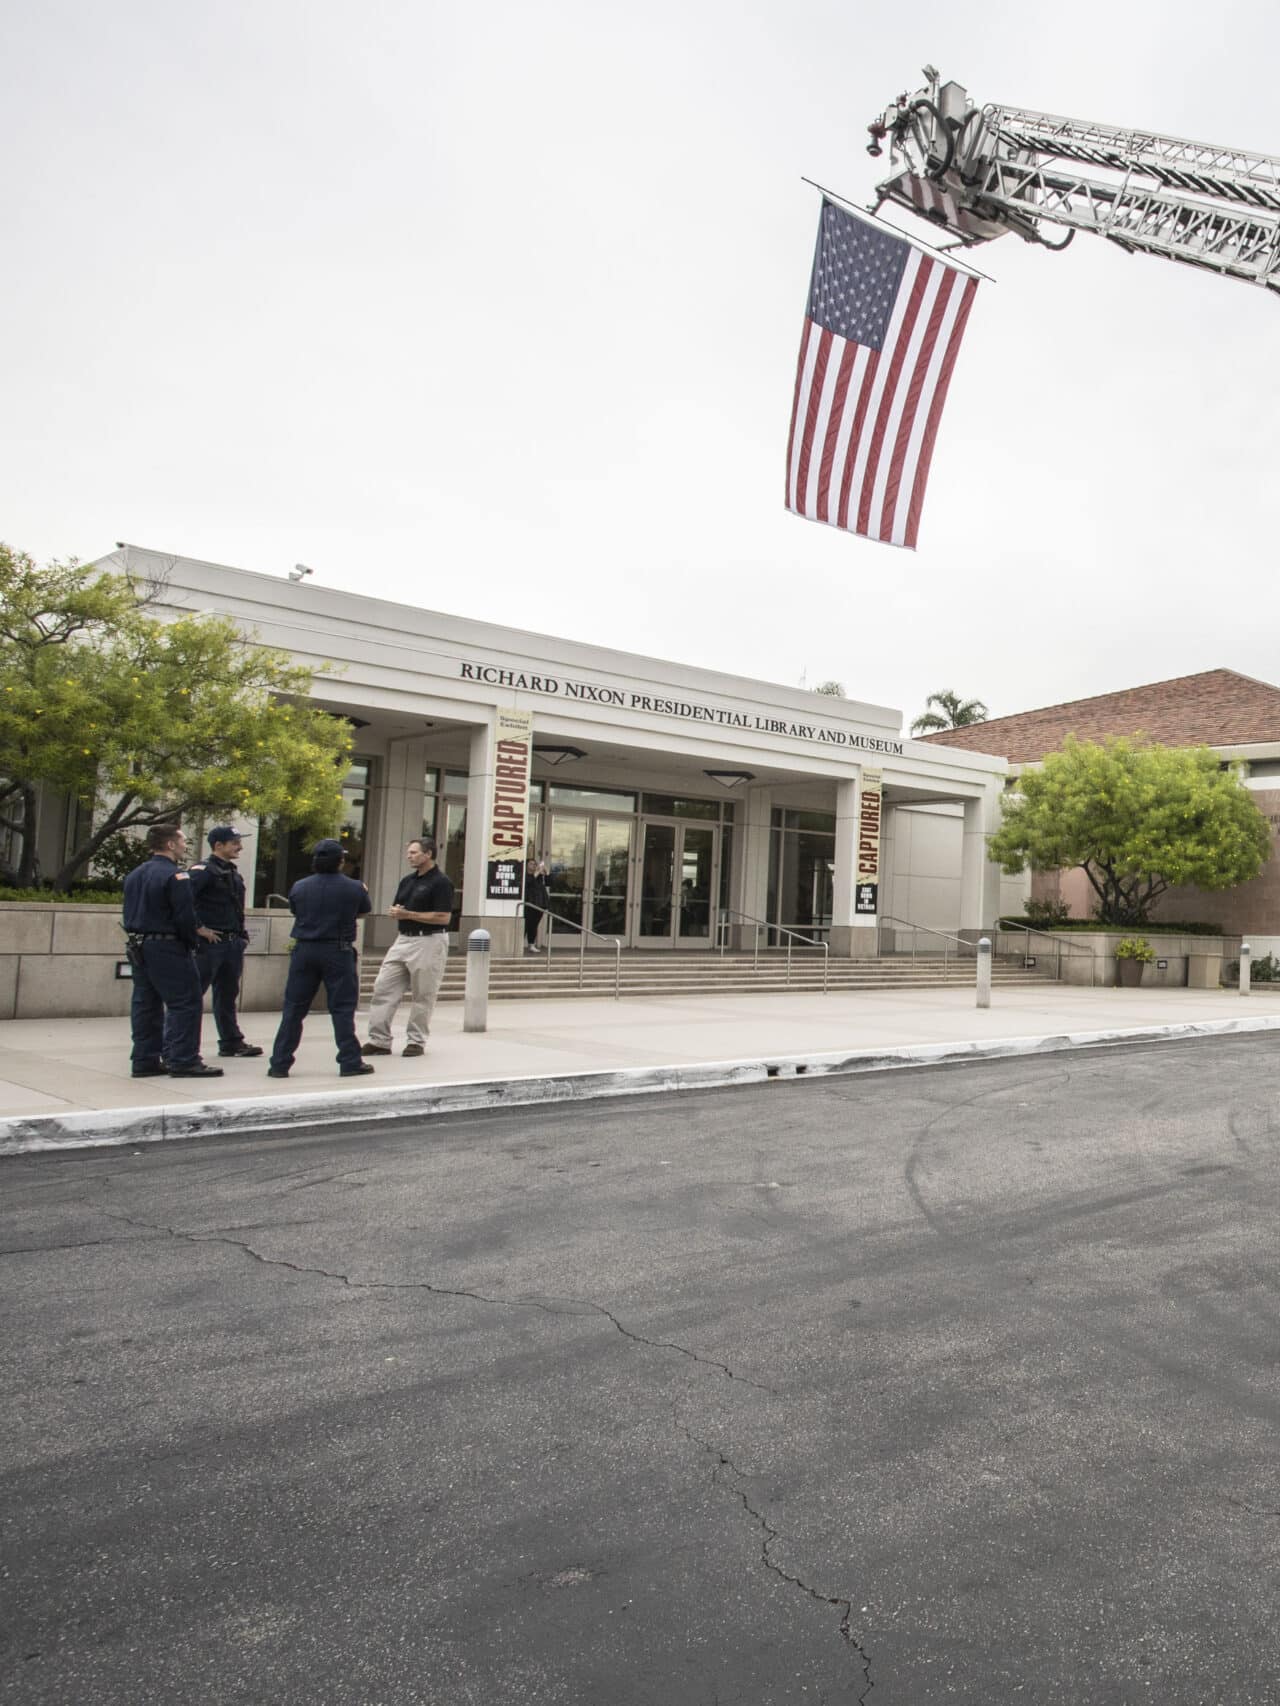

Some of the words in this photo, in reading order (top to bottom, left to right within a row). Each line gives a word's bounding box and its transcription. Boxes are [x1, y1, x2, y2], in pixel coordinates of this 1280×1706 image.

[461, 663, 559, 693] RICHARD
[565, 682, 626, 706] NIXON
[631, 694, 752, 728] PRESIDENTIAL
[755, 717, 816, 739] LIBRARY
[817, 729, 846, 744] AND
[848, 734, 904, 755] MUSEUM
[492, 740, 529, 847] CAPTURED
[858, 791, 880, 874] CAPTURED
[490, 886, 520, 894] VIETNAM
